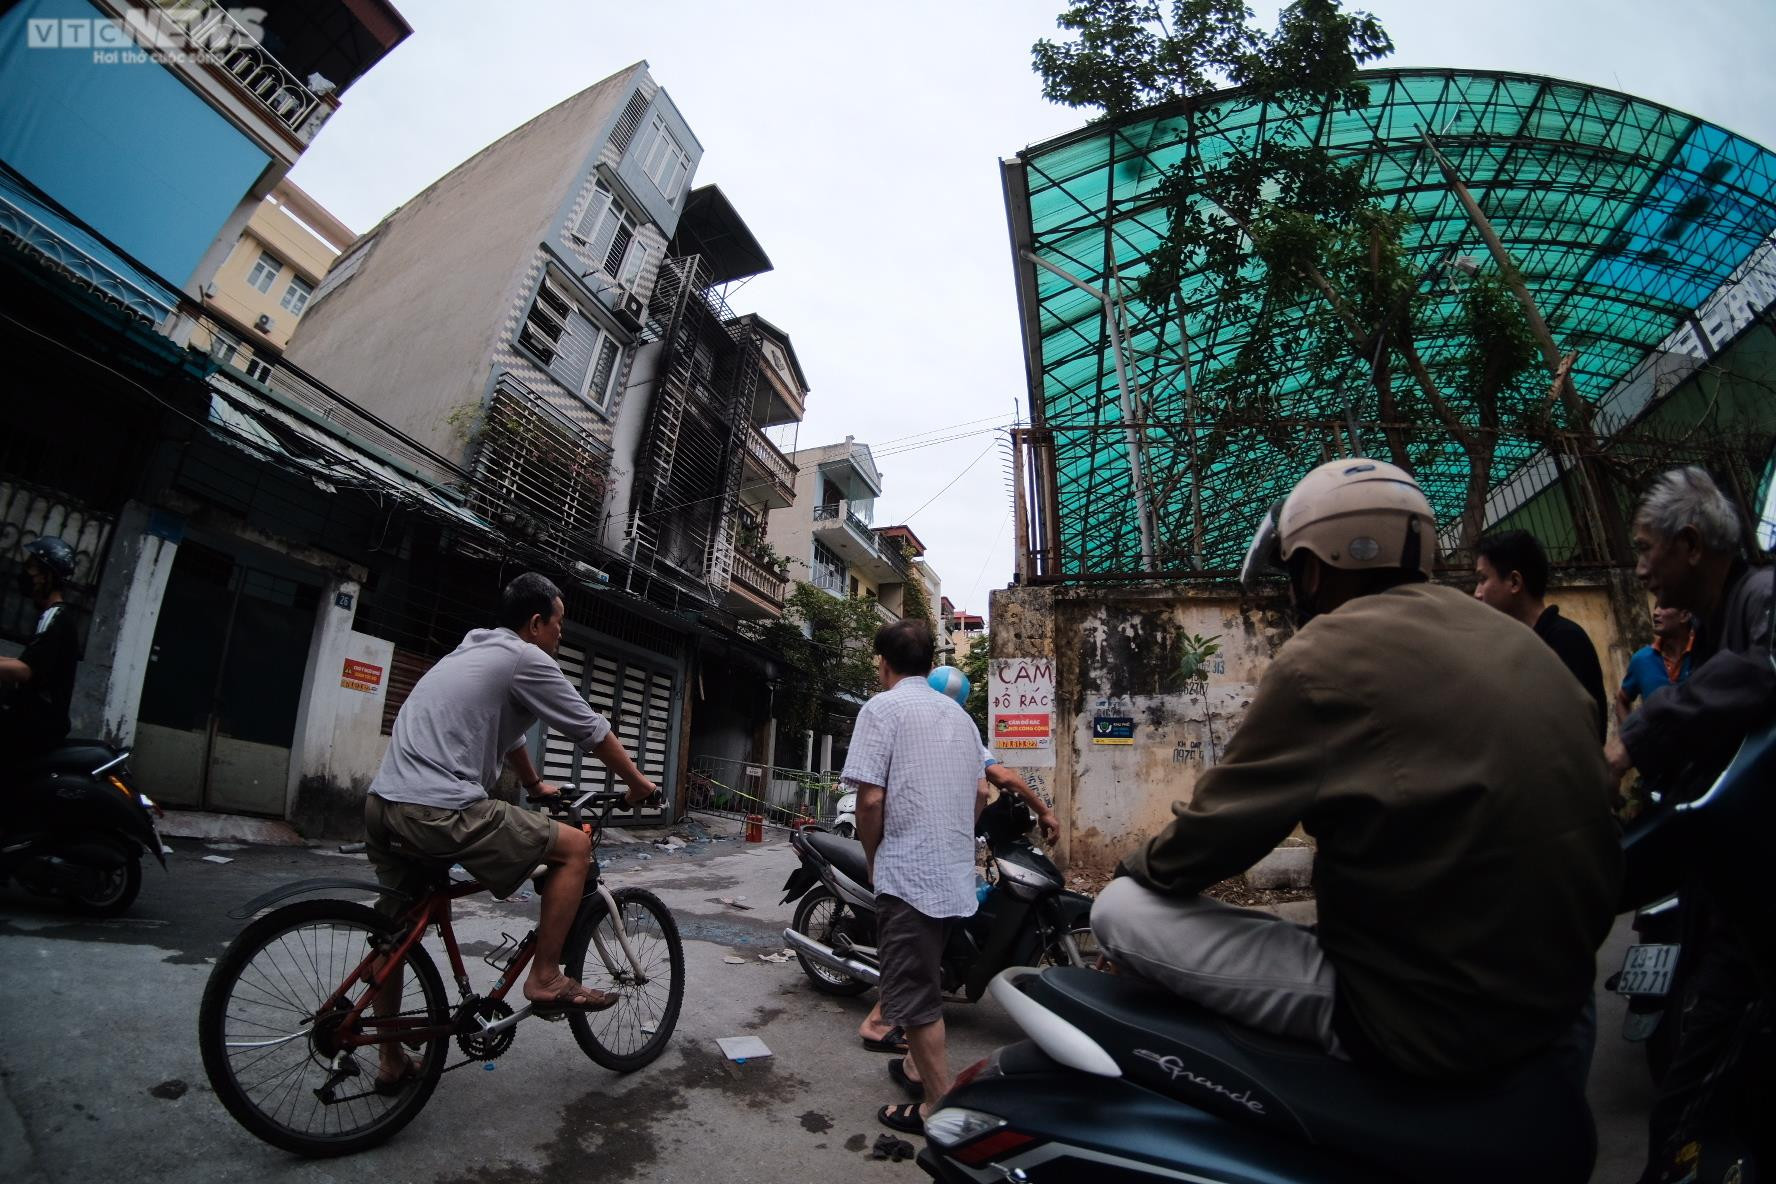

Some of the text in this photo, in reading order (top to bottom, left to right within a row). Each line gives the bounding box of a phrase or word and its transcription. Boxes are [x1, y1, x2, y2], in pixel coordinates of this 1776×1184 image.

[992, 687, 1049, 708] ĐỔ RÁC
[1160, 1056, 1265, 1114] Grande
